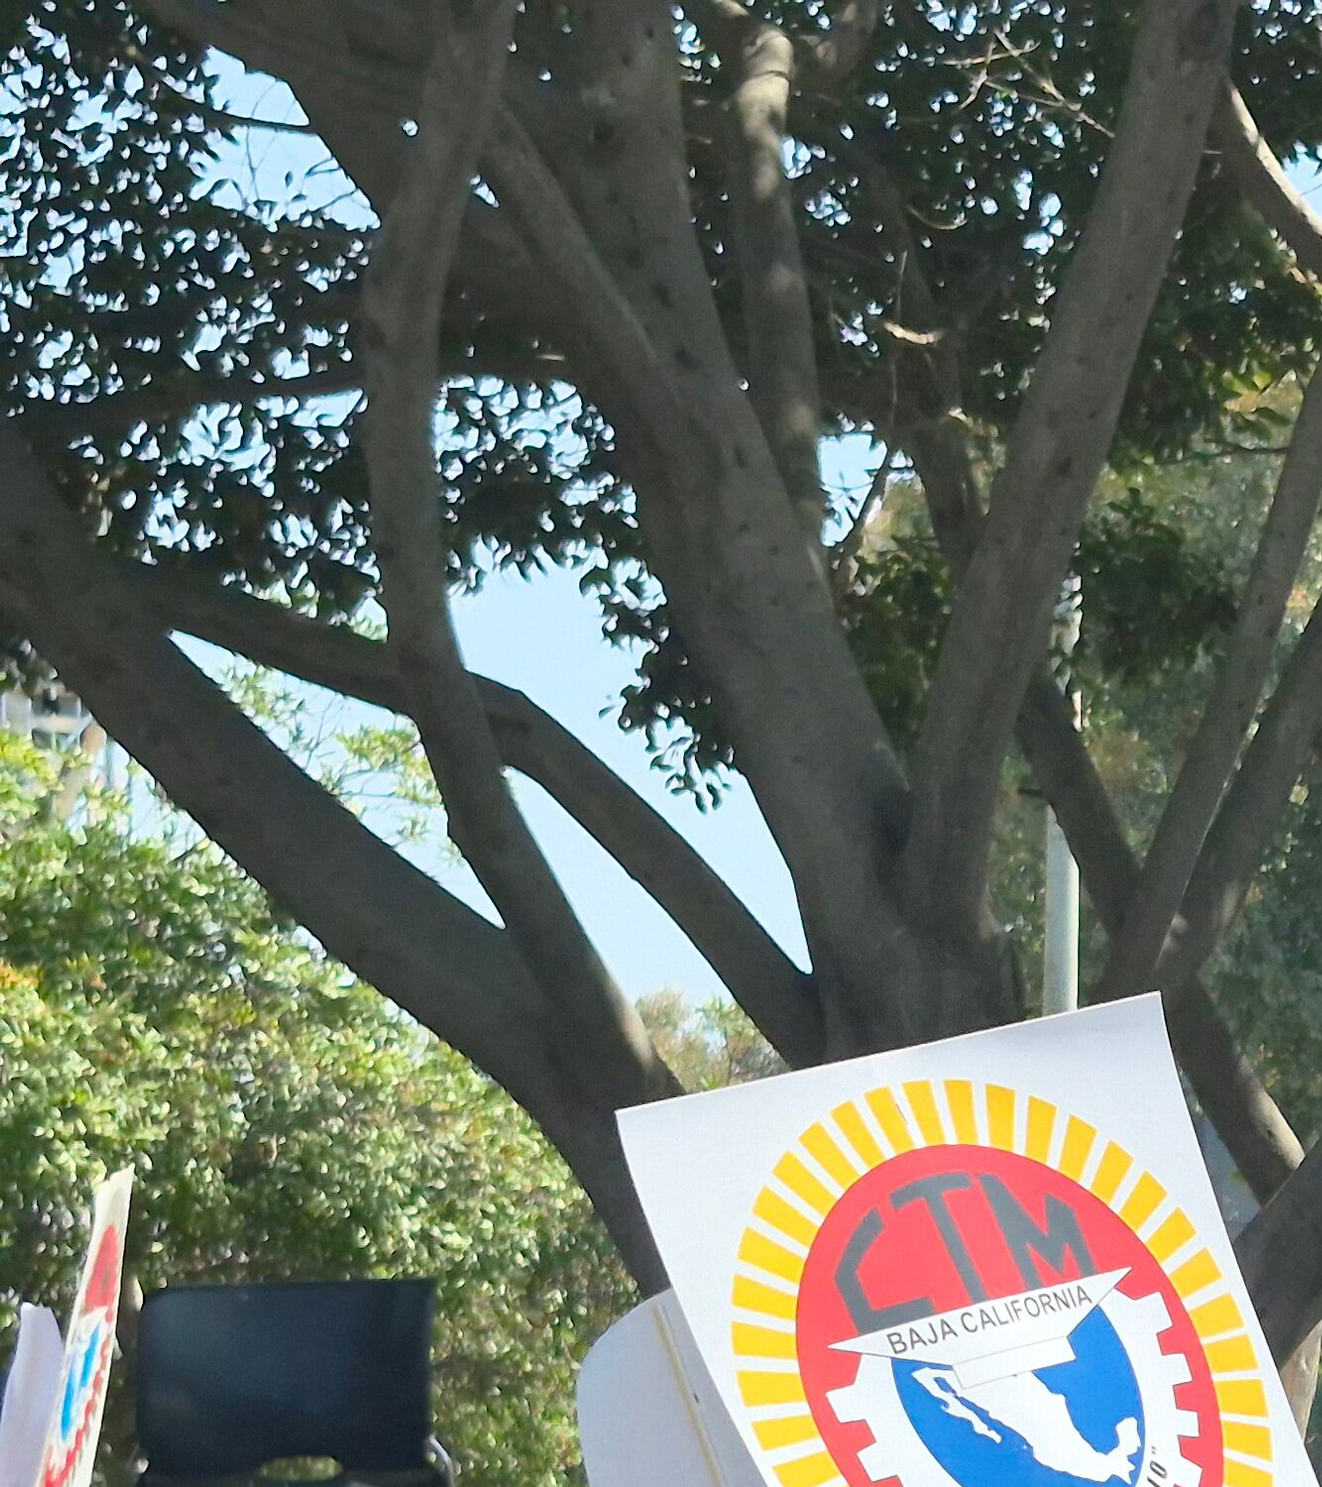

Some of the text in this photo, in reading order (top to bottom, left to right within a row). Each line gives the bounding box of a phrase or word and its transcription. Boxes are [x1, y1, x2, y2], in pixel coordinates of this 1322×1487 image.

[835, 1171, 1096, 1335] CTM
[886, 1284, 1094, 1356] BAJA CALIFORNIA
